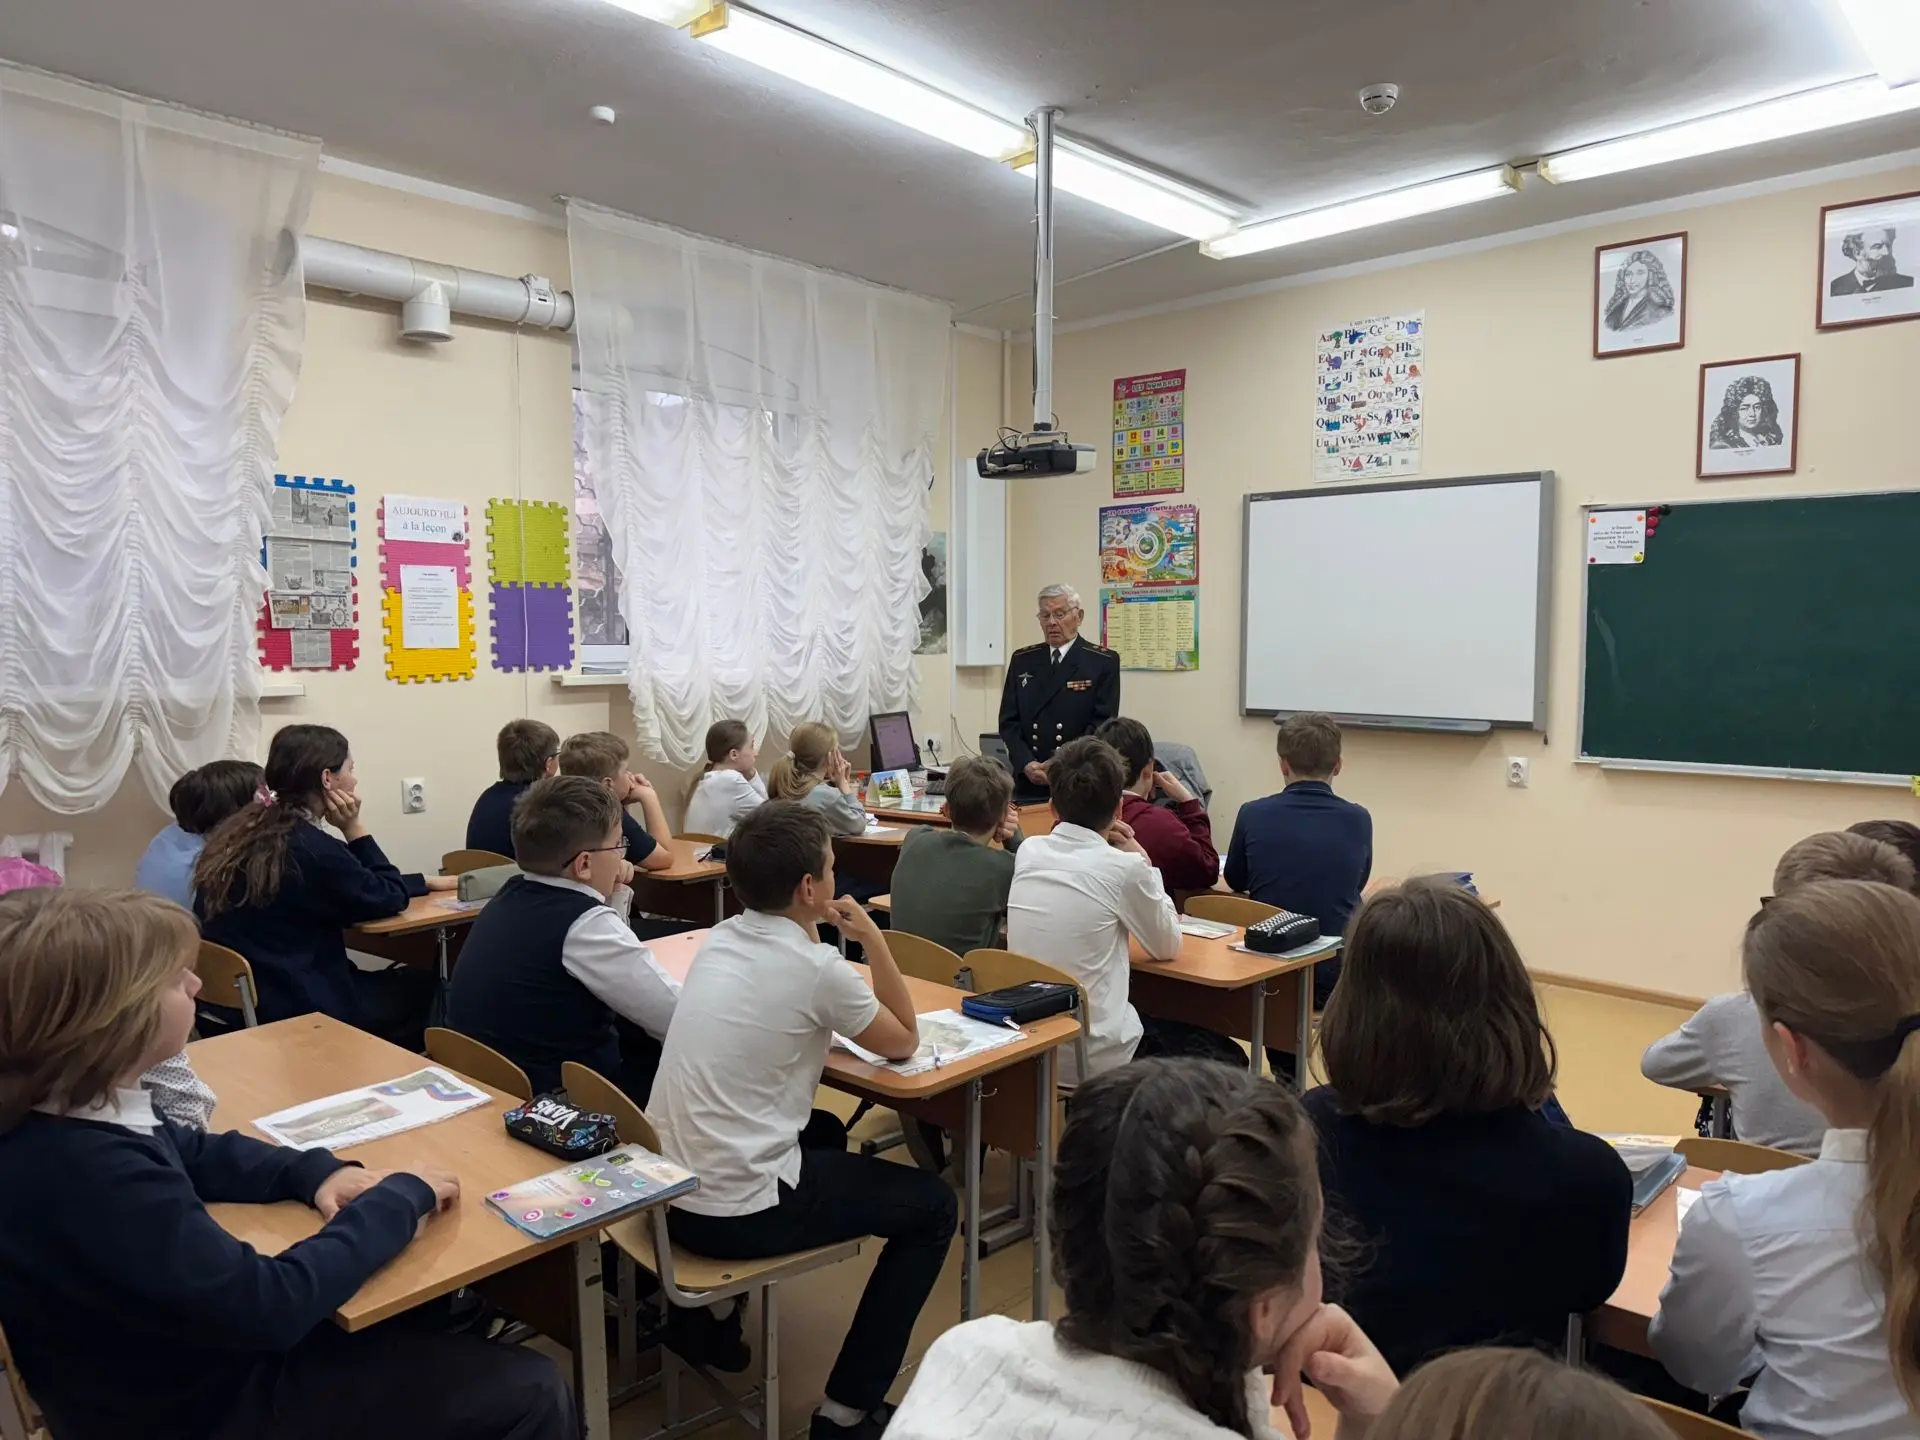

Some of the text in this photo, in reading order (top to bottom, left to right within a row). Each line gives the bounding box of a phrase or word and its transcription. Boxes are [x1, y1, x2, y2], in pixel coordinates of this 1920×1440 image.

[1369, 325, 1383, 335] Cc
[1343, 350, 1355, 360] Ff
[1396, 342, 1412, 353] Hh
[1342, 371, 1352, 383] Jj
[1369, 368, 1383, 378] Kk
[1396, 364, 1406, 375] Ll
[1342, 393, 1356, 402] Nn
[1368, 390, 1382, 400] Oo
[1395, 387, 1408, 398] Pp
[1367, 412, 1379, 421] Ss
[1316, 438, 1329, 448] Uu
[1341, 457, 1353, 467] Yy
[403, 520, 447, 534] à la leçon
[525, 1098, 580, 1130] VANS
